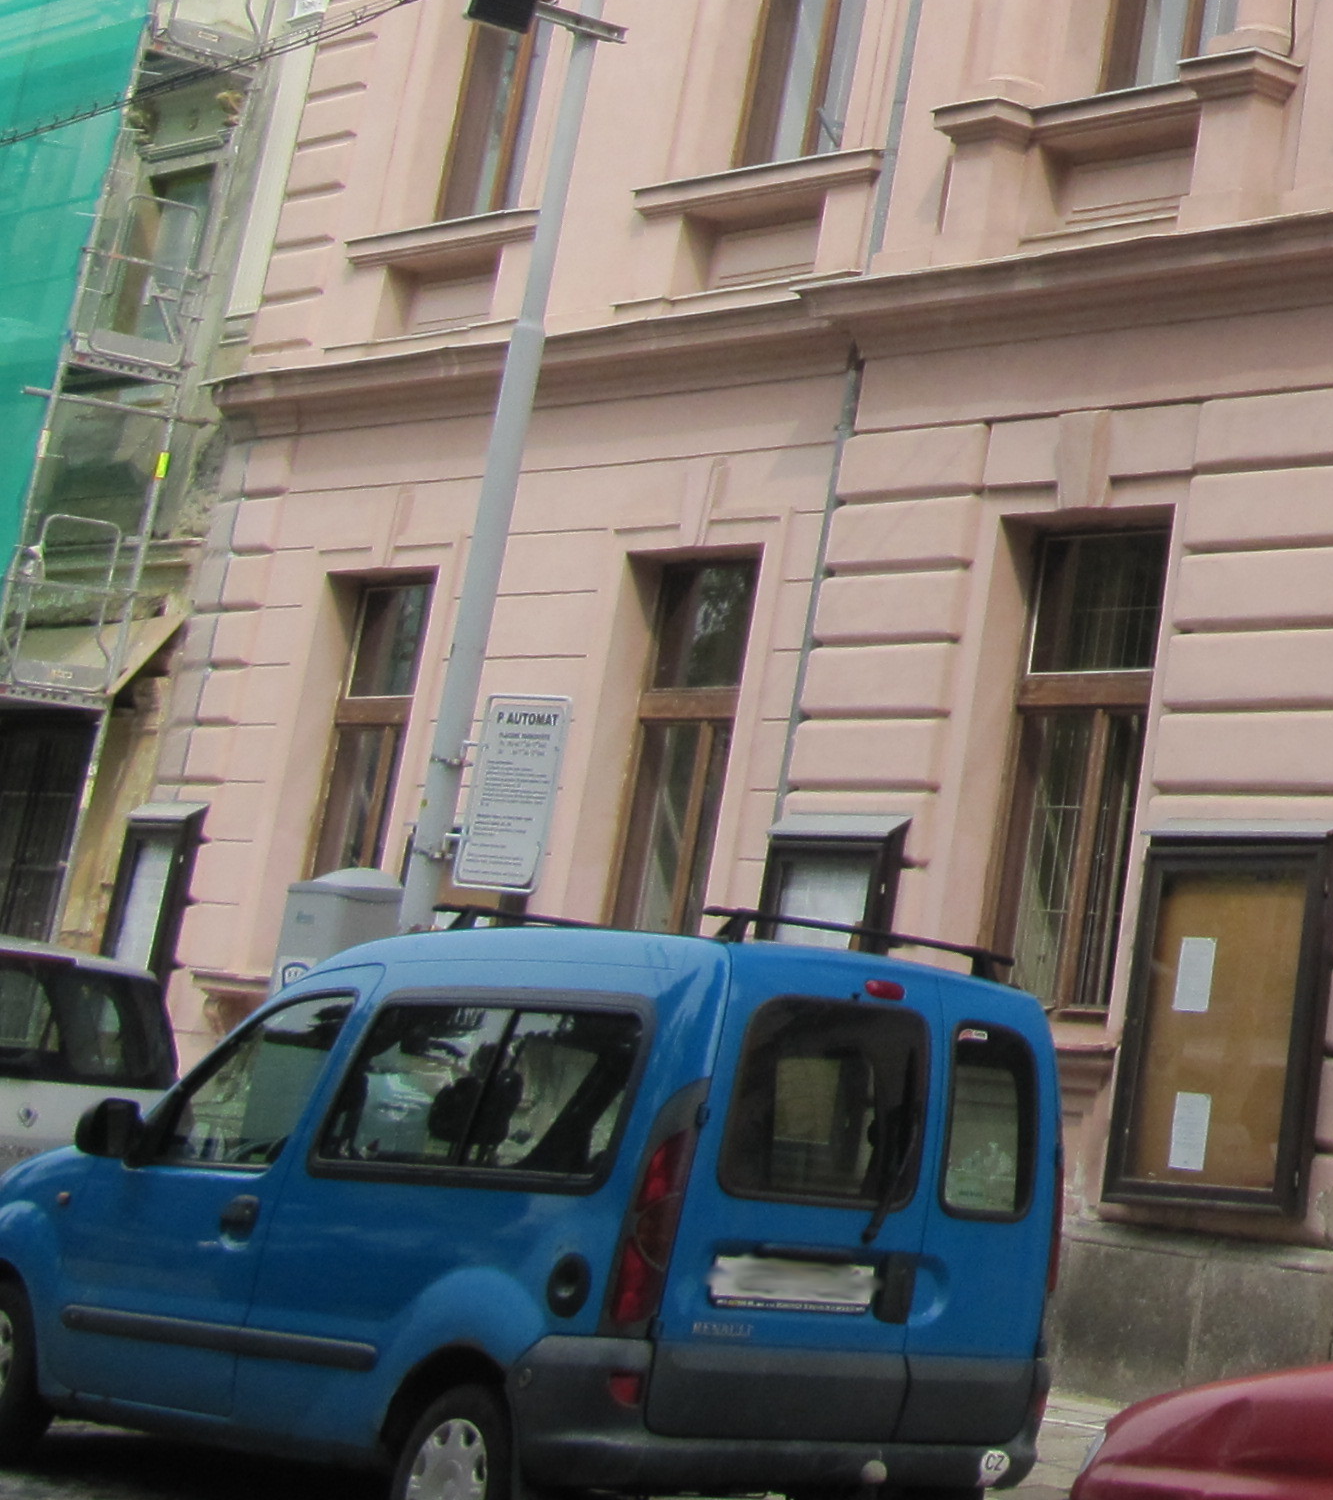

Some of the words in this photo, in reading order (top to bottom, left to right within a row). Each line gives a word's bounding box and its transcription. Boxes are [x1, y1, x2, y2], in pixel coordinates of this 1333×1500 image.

[497, 711, 505, 724] P
[506, 712, 560, 726] AUTOMAT
[985, 1453, 1005, 1471] CZ
